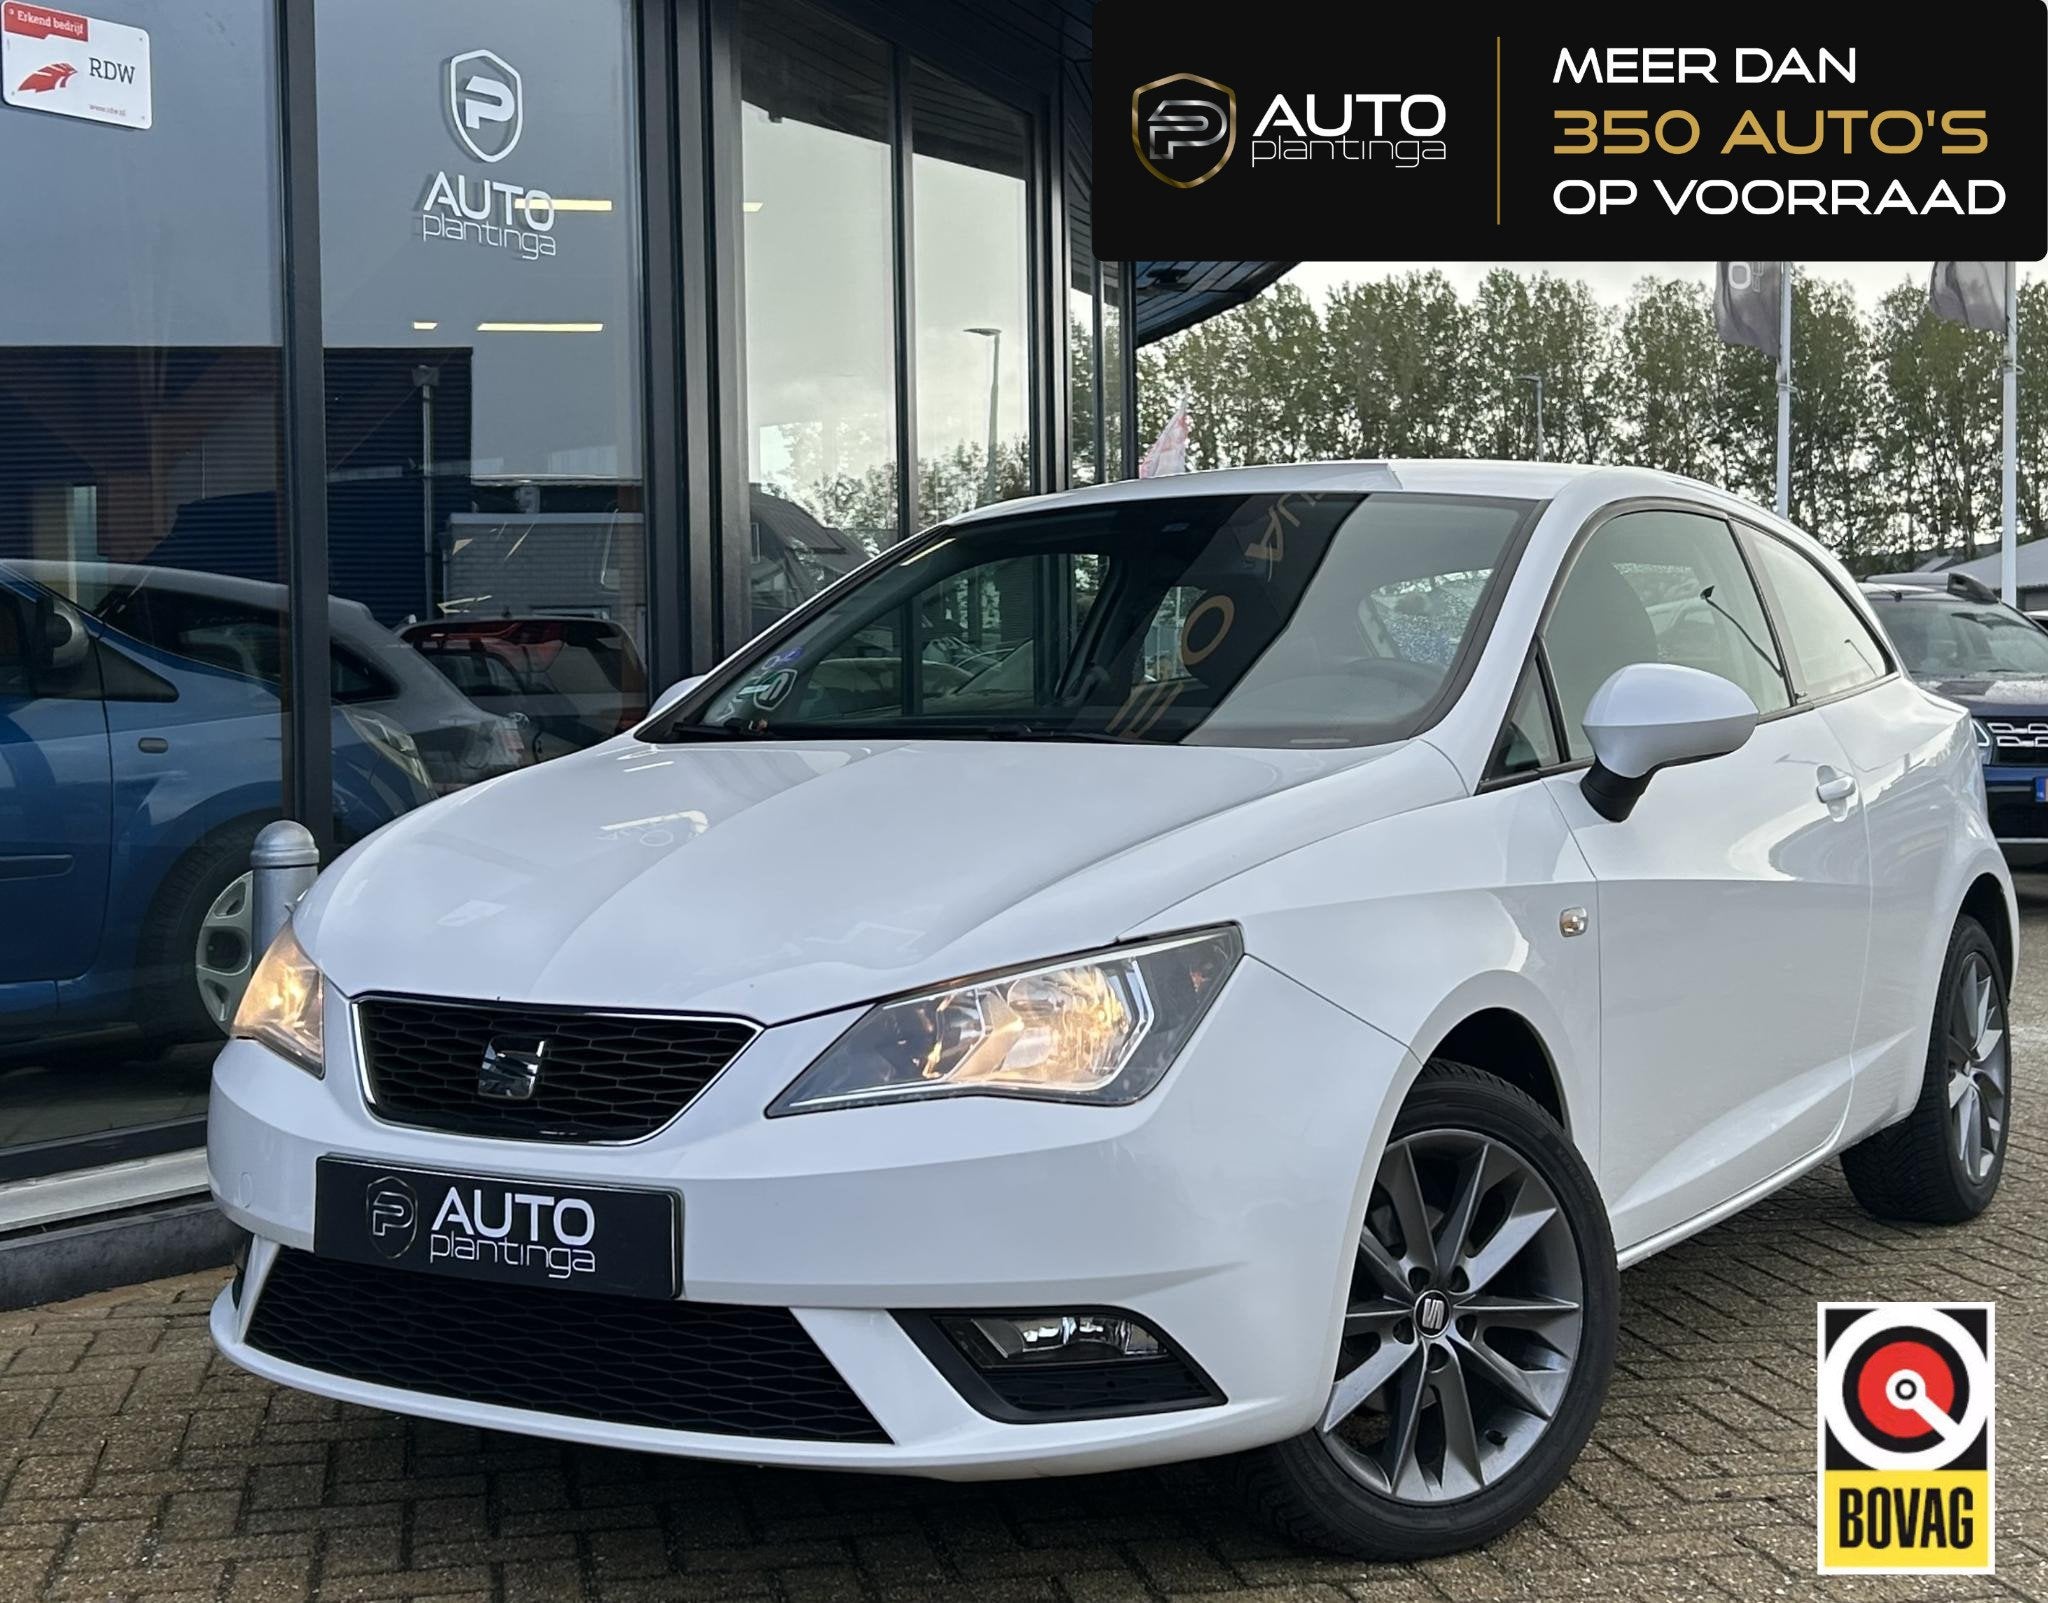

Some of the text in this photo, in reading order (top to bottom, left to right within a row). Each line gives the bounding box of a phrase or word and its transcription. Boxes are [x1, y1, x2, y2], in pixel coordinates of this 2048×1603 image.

[17, 10, 84, 36] Erkend bedrijf
[88, 57, 136, 85] RDW
[423, 171, 555, 232] AUTO
[423, 213, 556, 260] plantinga
[431, 1186, 596, 1246] AUTO
[430, 1230, 596, 1279] plantinga
